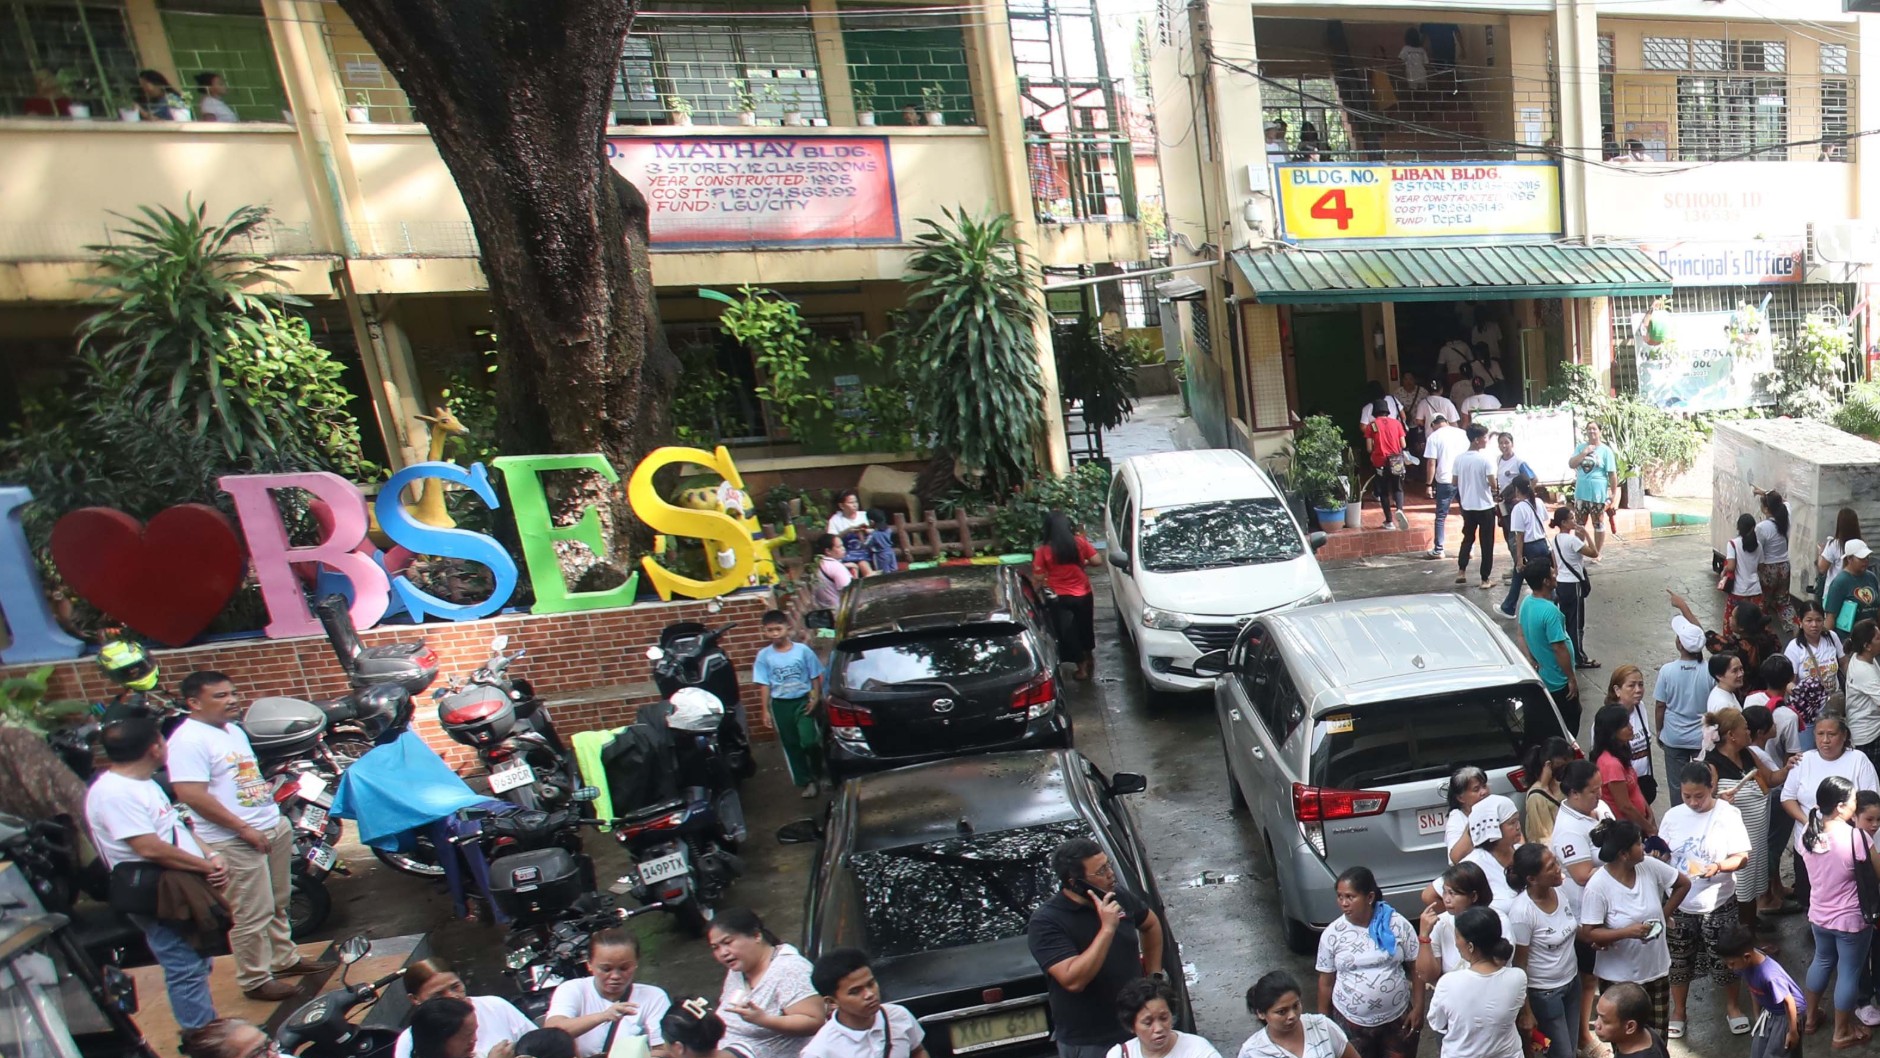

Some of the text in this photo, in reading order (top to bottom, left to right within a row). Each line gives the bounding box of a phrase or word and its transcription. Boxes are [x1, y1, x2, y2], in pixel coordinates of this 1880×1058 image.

[655, 141, 798, 159] MATHAY
[803, 147, 872, 158] BLDG.
[766, 161, 877, 173] CLASSROOMS
[648, 175, 688, 187] YEAR
[694, 174, 809, 187] CONSTRUCTED:
[1293, 169, 1380, 185] BLDG. NO.
[1391, 168, 1446, 182] LIBAN
[651, 187, 709, 199] COST:
[656, 199, 810, 214] FUND: LGU/CITY
[1310, 188, 1354, 231] 4
[1744, 250, 1792, 275] Office
[1562, 844, 1576, 859] 12
[641, 858, 685, 880] 149PTX
